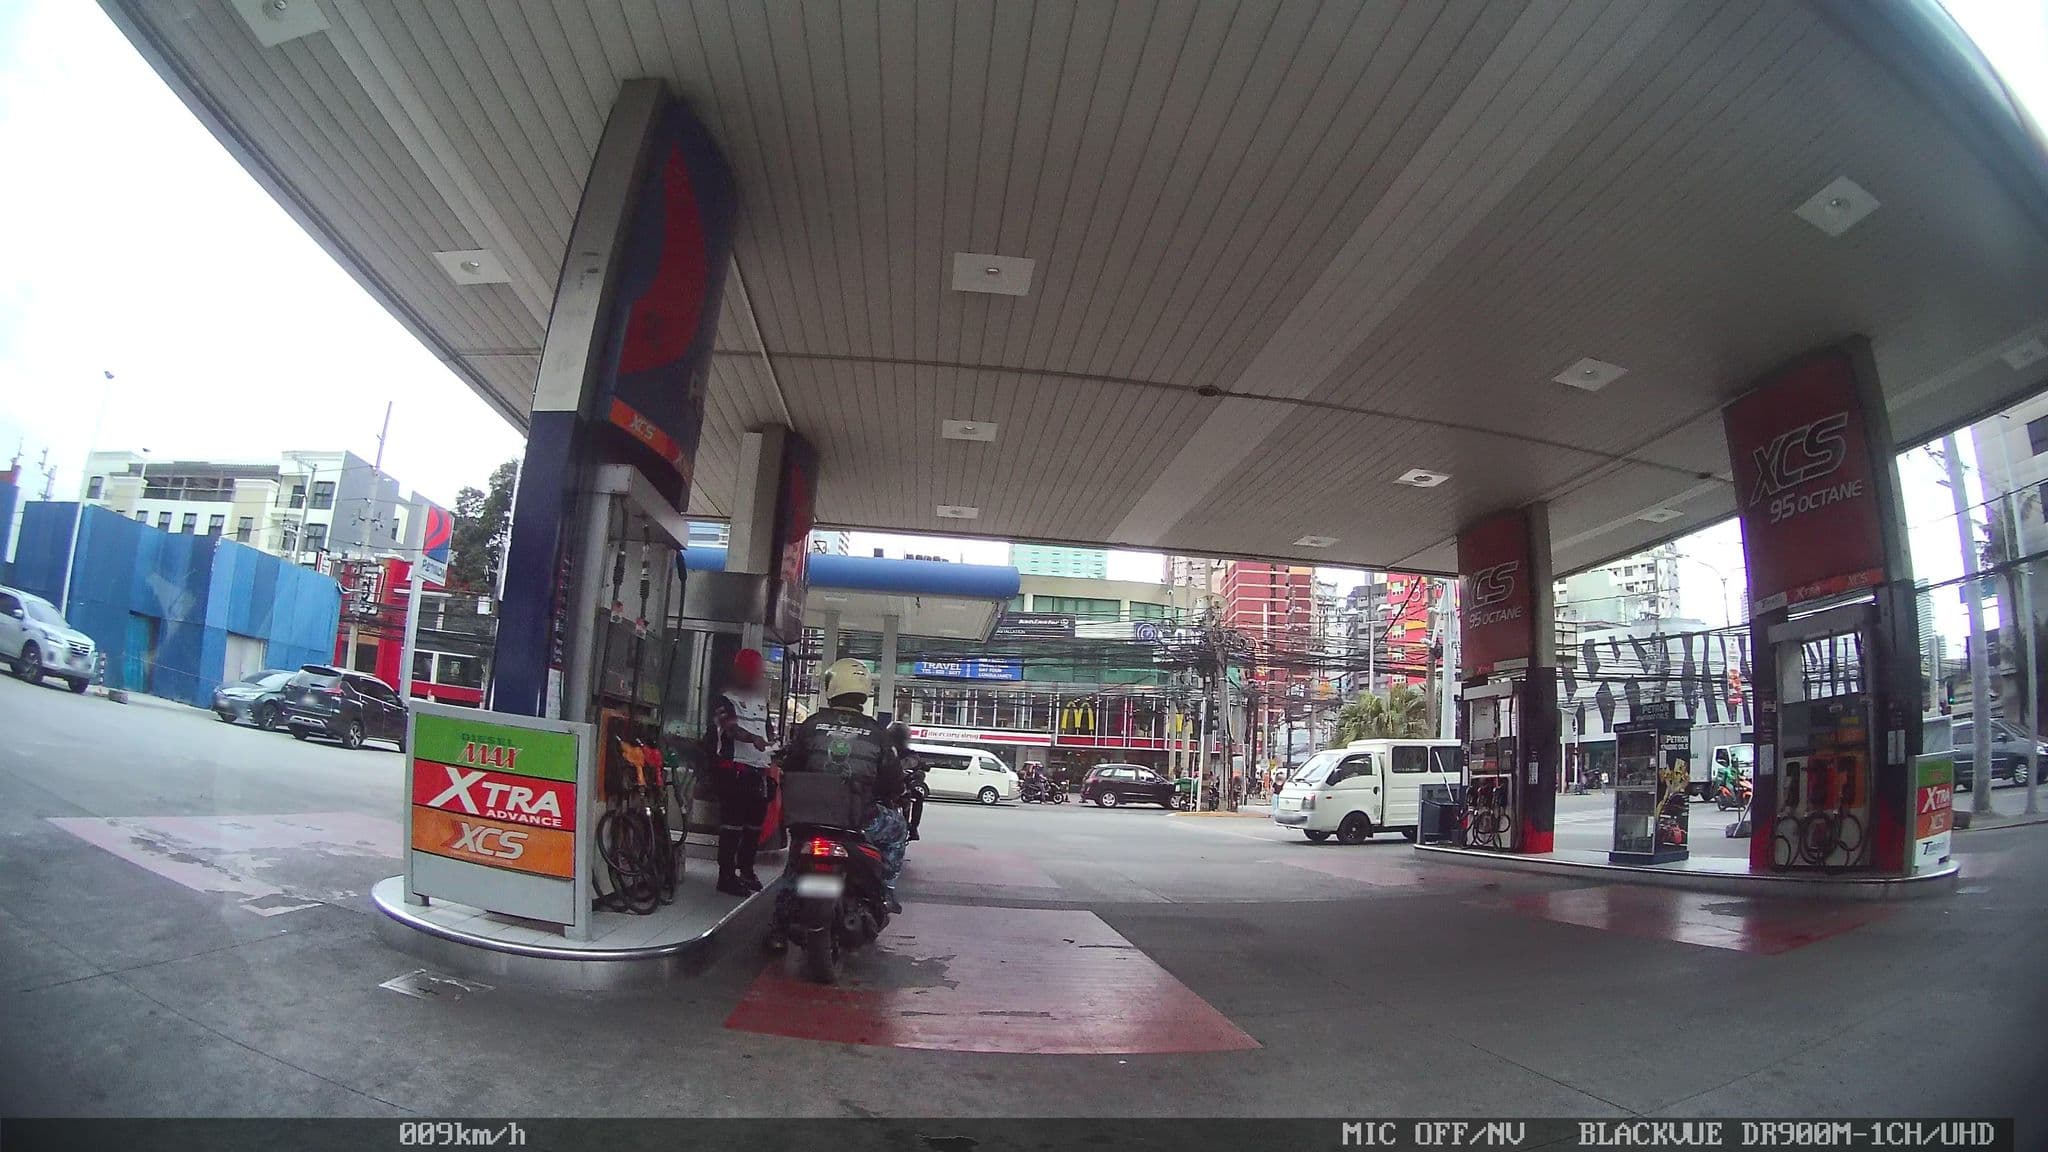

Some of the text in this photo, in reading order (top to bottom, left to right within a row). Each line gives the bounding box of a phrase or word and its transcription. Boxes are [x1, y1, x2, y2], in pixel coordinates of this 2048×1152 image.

[1750, 412, 1849, 506] XCS
[1770, 479, 1864, 524] 95 OCTANE
[1469, 607, 1522, 629] 95 OCTANE
[922, 661, 961, 671] TRAVEL
[1643, 703, 1669, 714] PETRON
[461, 732, 513, 746] DIESEL
[1666, 735, 1688, 743] PETRON
[457, 742, 522, 769] MAX
[426, 767, 562, 817] XTRA
[486, 809, 562, 827] ADVANCE
[451, 822, 529, 860] XCS
